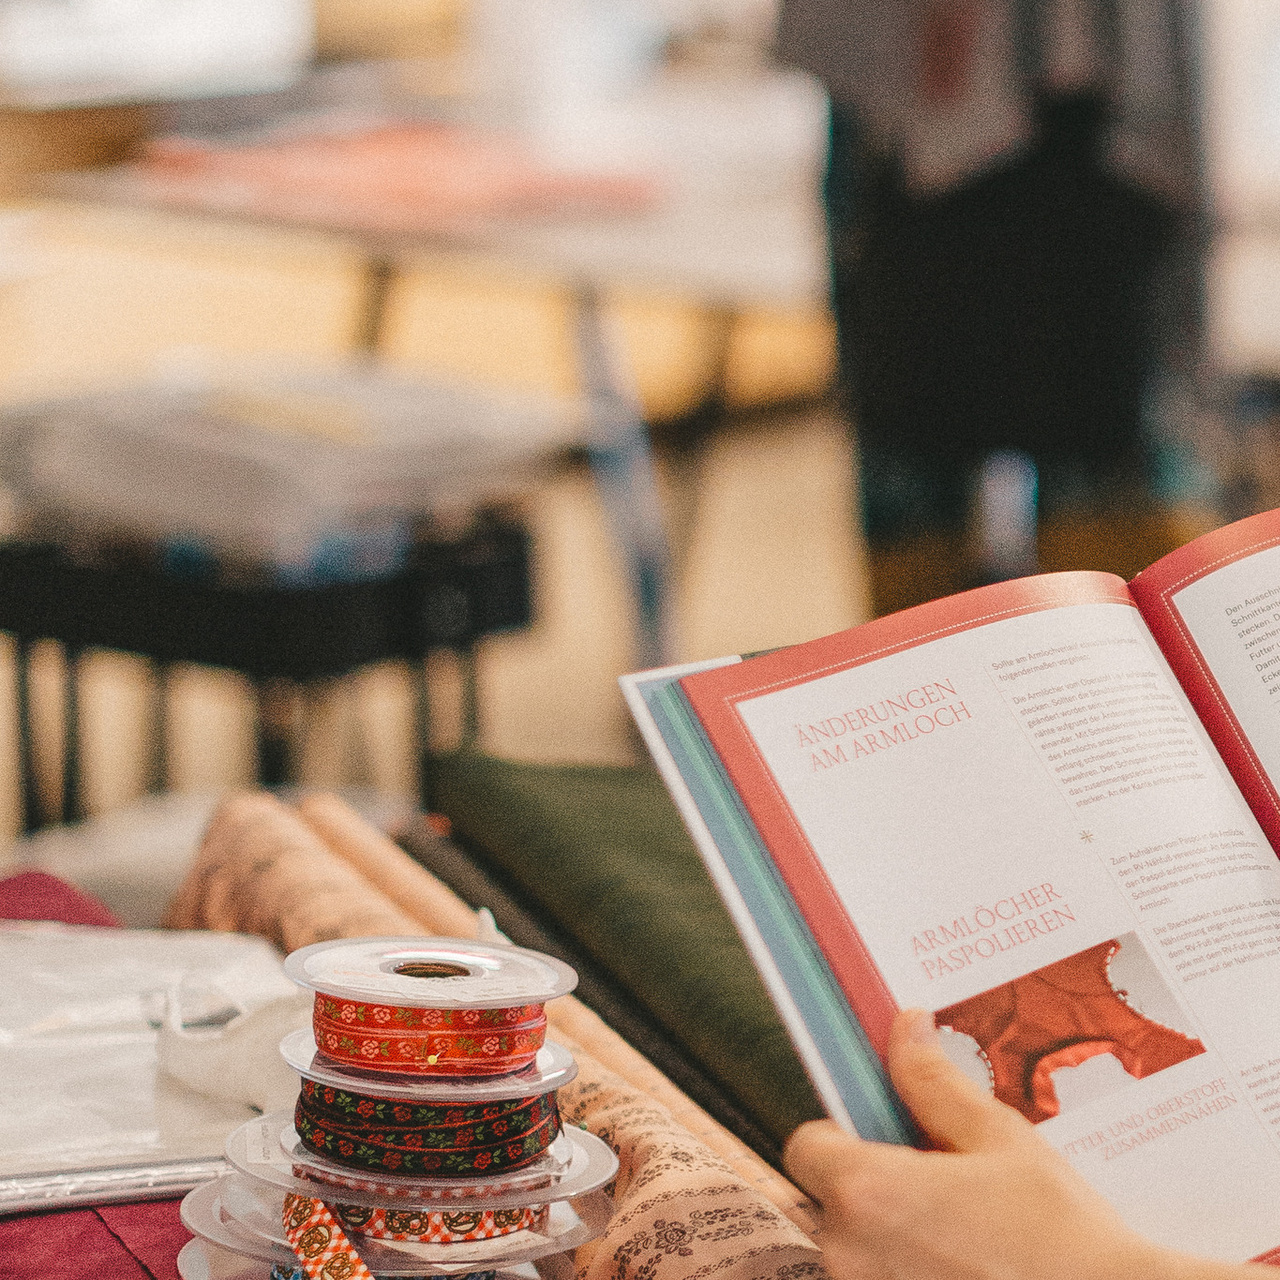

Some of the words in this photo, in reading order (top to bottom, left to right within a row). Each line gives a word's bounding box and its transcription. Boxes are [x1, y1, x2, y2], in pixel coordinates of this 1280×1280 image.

[795, 678, 958, 748] ÄNDERUNGEN
[811, 744, 849, 772] AM
[853, 701, 972, 759] ARMLOCH
[912, 882, 1063, 956] ARMLÖCHER
[921, 904, 1077, 980] PASPOLIEREN
